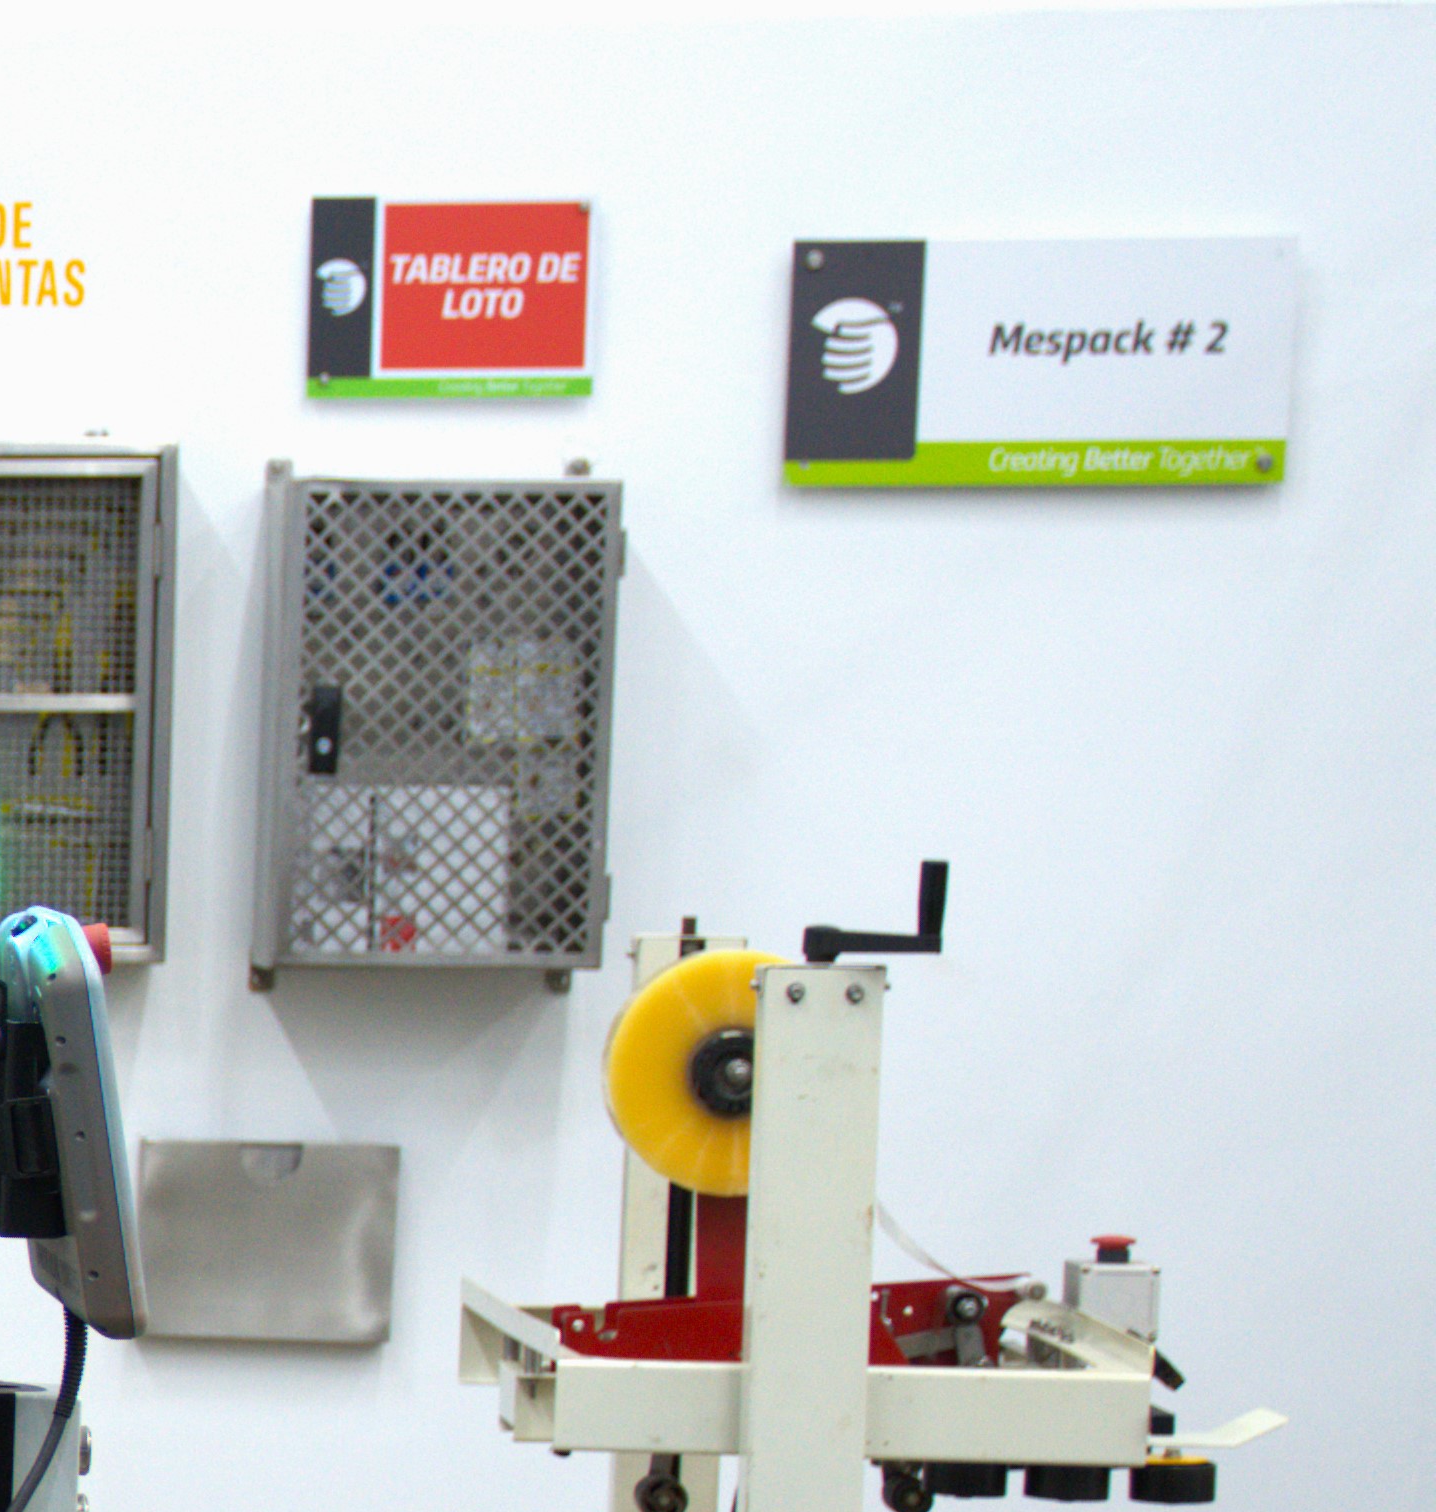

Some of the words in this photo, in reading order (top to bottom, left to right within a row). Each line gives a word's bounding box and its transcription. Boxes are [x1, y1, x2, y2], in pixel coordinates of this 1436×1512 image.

[390, 253, 531, 284] TABLERO
[537, 253, 581, 283] DE
[442, 289, 524, 320] LOTO
[989, 321, 1153, 363] Mespack
[1167, 323, 1194, 354] #
[1206, 322, 1230, 354] 2
[989, 447, 1076, 477] Creating
[1083, 448, 1152, 471] Better
[1158, 447, 1249, 476] Together
